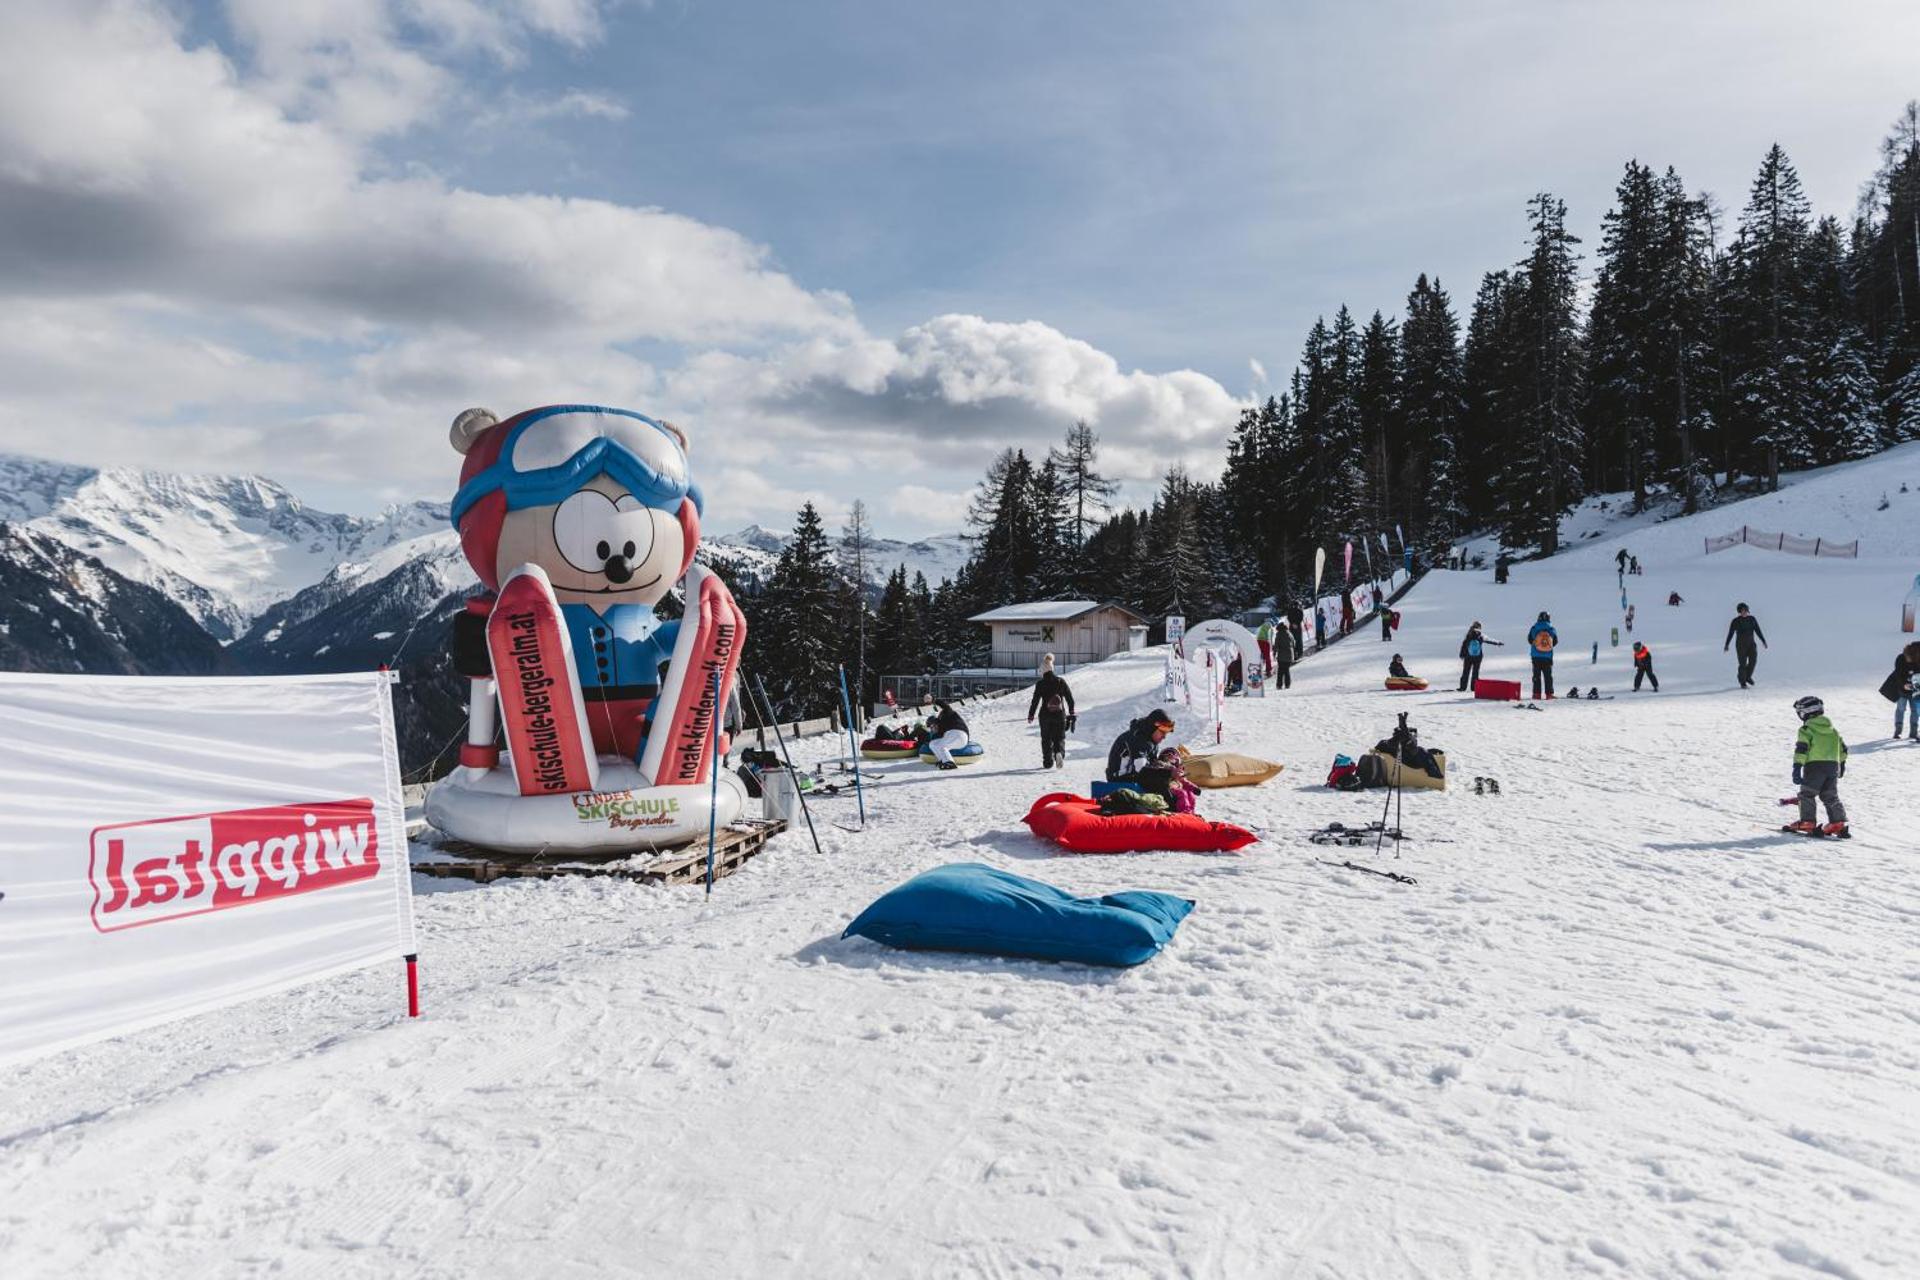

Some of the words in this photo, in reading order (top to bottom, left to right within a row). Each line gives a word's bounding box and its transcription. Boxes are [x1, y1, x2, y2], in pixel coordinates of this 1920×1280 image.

[506, 612, 568, 790] skischule-bergeralm.at
[571, 789, 633, 808] KINDER
[577, 797, 681, 820] SKISCHULE
